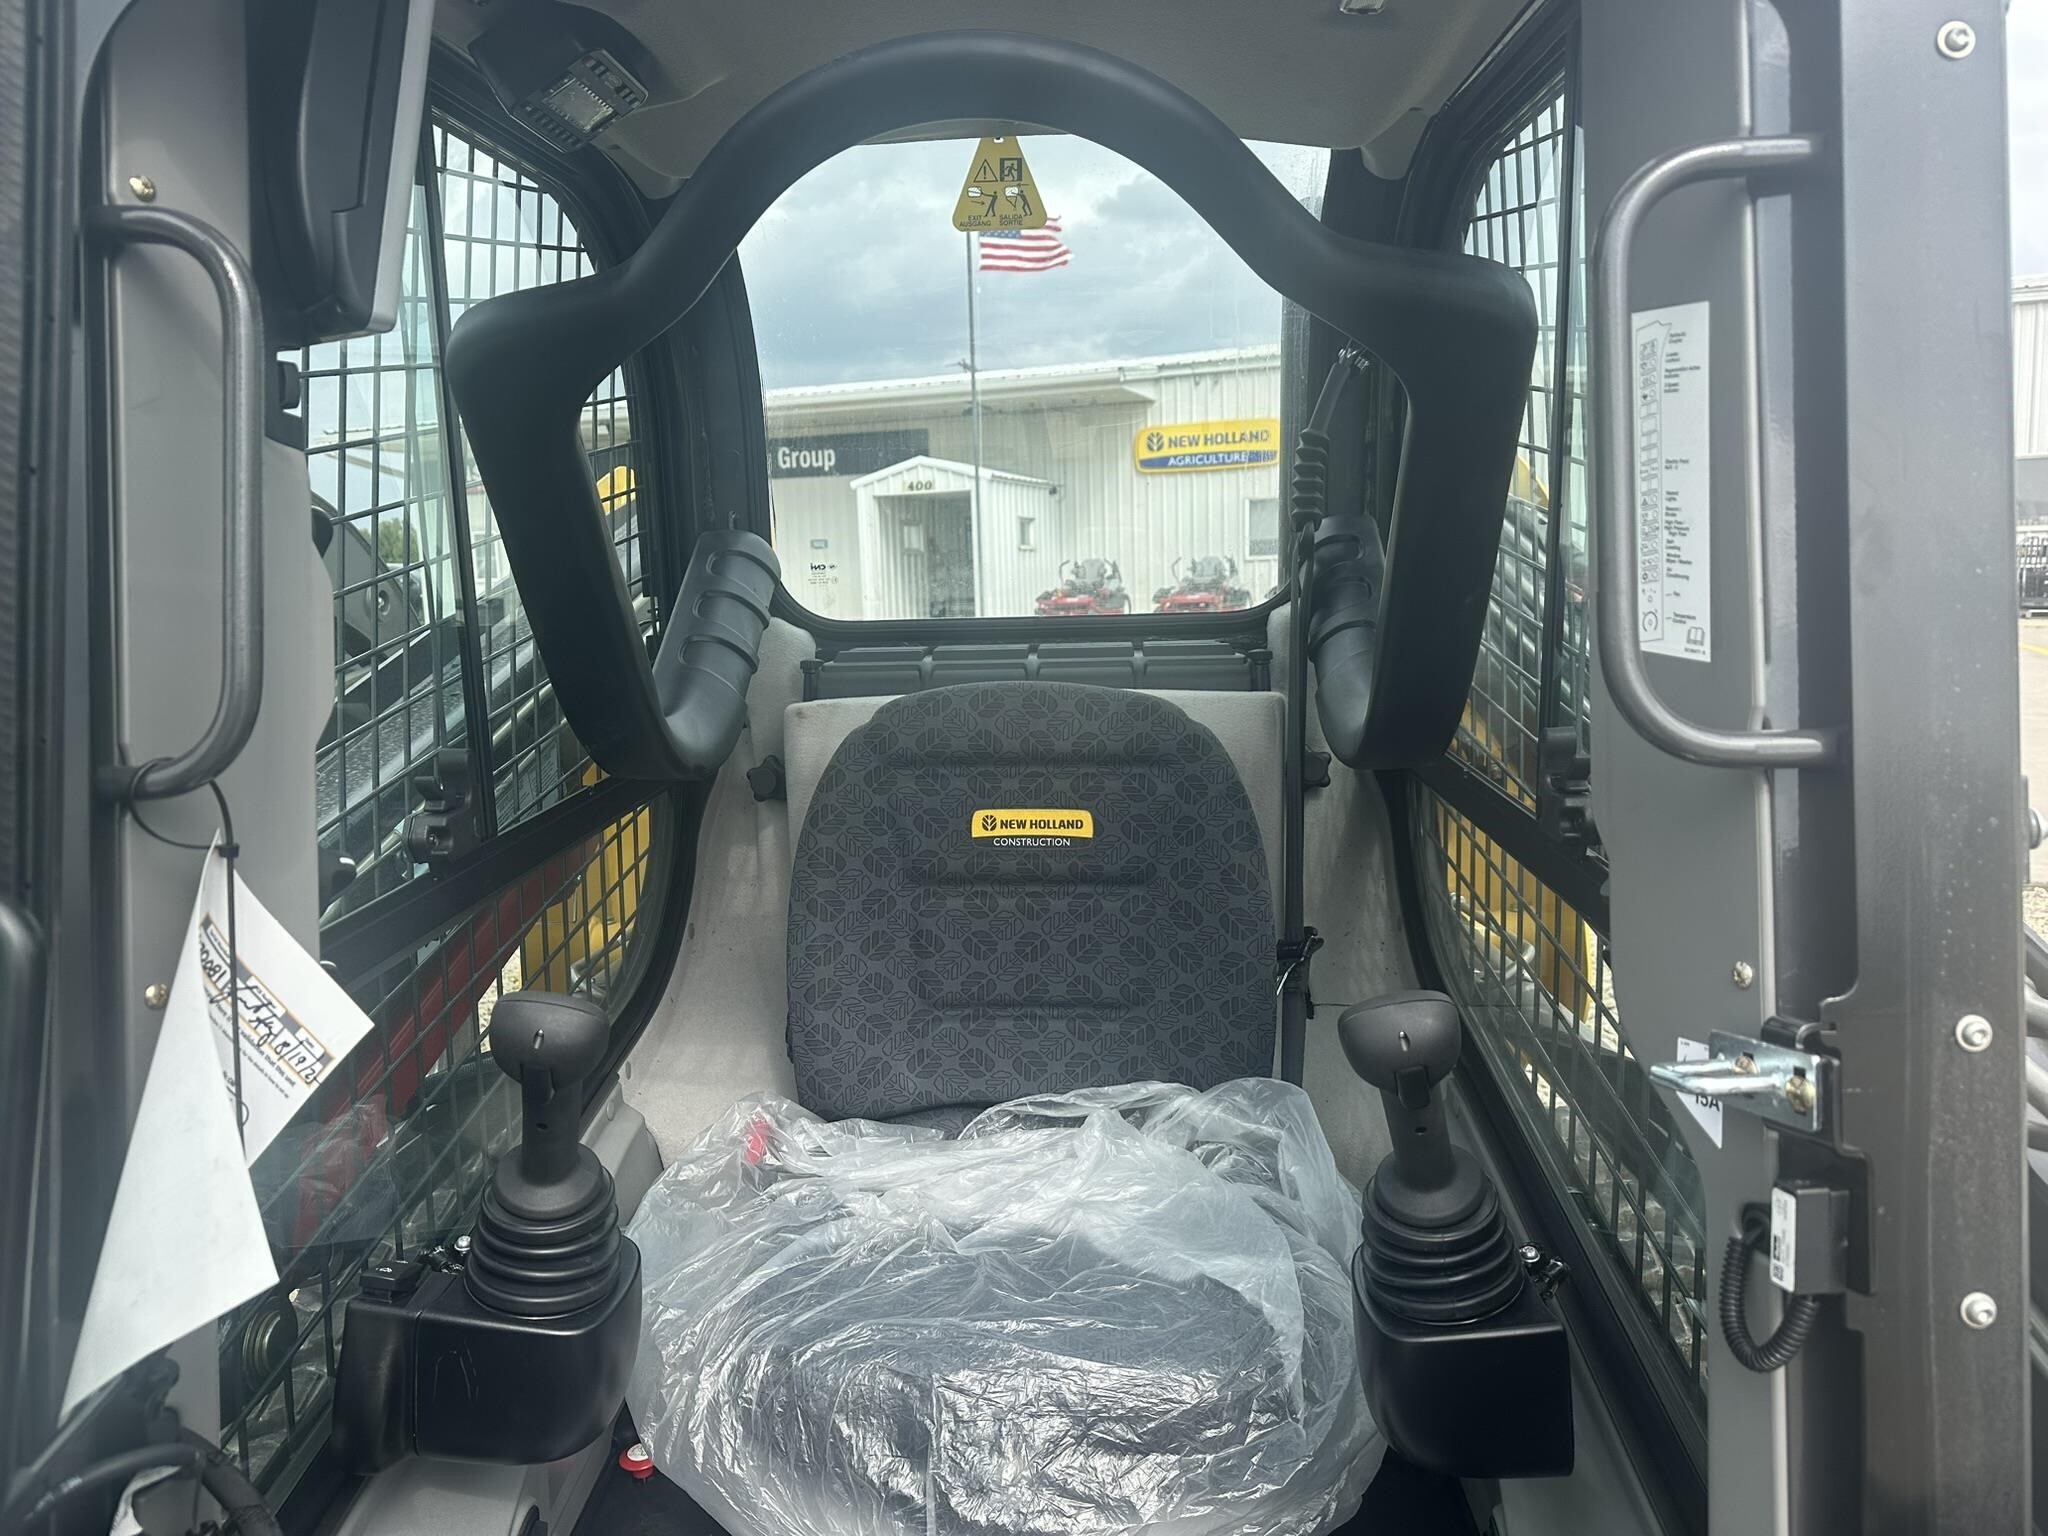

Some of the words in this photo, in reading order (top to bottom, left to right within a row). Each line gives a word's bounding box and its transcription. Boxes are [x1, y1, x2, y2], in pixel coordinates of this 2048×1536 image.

[959, 220, 991, 228] AUSGANG
[1168, 435, 1200, 449] NEW
[1203, 429, 1270, 446] HOLLAND
[777, 447, 836, 472] Group
[1168, 451, 1249, 467] AGRICULTURE
[908, 481, 933, 491] 400
[1000, 819, 1027, 829] NEW
[1029, 819, 1084, 829] HOLLAND
[993, 837, 1071, 847] CONSTRUCTION
